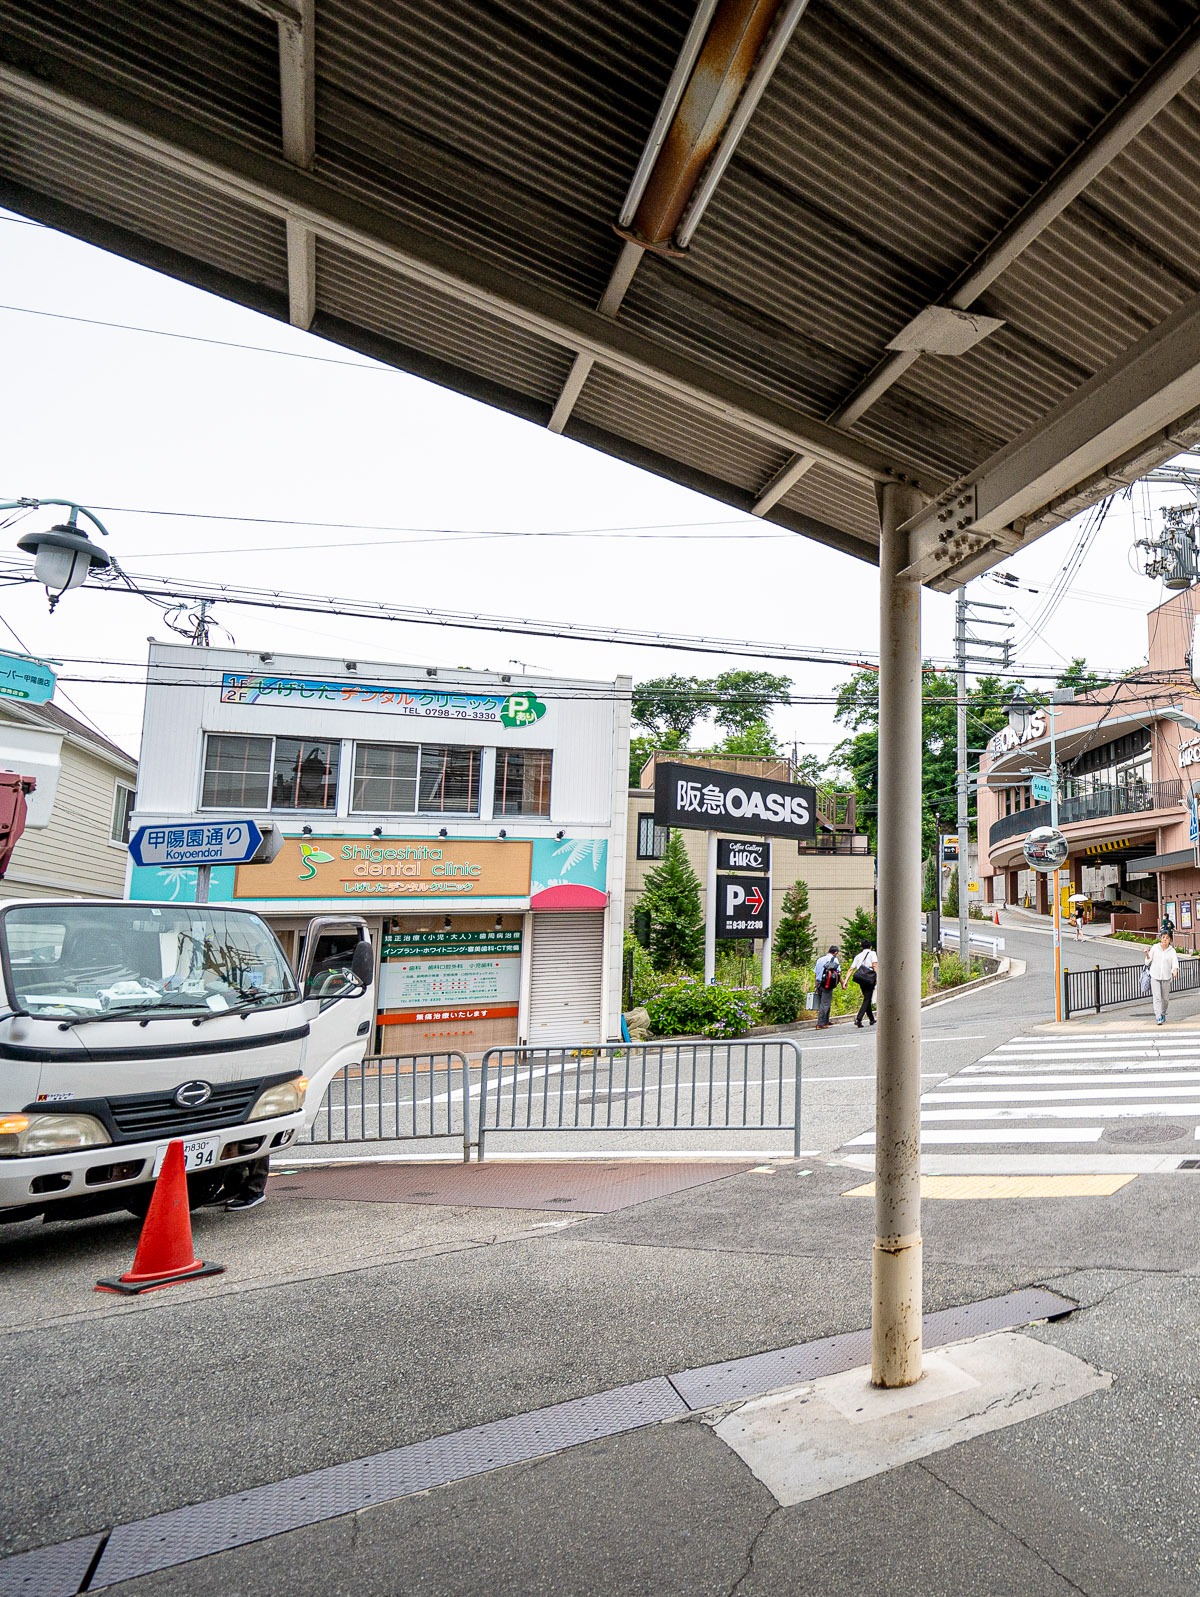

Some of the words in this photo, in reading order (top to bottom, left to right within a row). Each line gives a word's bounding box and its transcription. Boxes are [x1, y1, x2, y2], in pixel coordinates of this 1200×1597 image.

[228, 677, 248, 689] 1F
[226, 690, 248, 701] 2F
[403, 706, 420, 715] TEL
[425, 708, 496, 720] 0798-70-3330
[508, 696, 529, 718] P
[676, 780, 810, 825] 阪急OASIS
[148, 827, 242, 850] 甲陽園通り
[166, 847, 223, 860] Koyoendori
[340, 845, 443, 863] Shigeshita
[729, 842, 745, 851] Coffee
[744, 844, 763, 853] Gallery
[729, 851, 764, 868] HIRO
[353, 861, 421, 876] dental
[431, 861, 482, 876] clinic
[344, 882, 473, 893] しげしたデンタルクリニック
[726, 884, 745, 915] P
[415, 1010, 488, 1021] 無痛治療いたします
